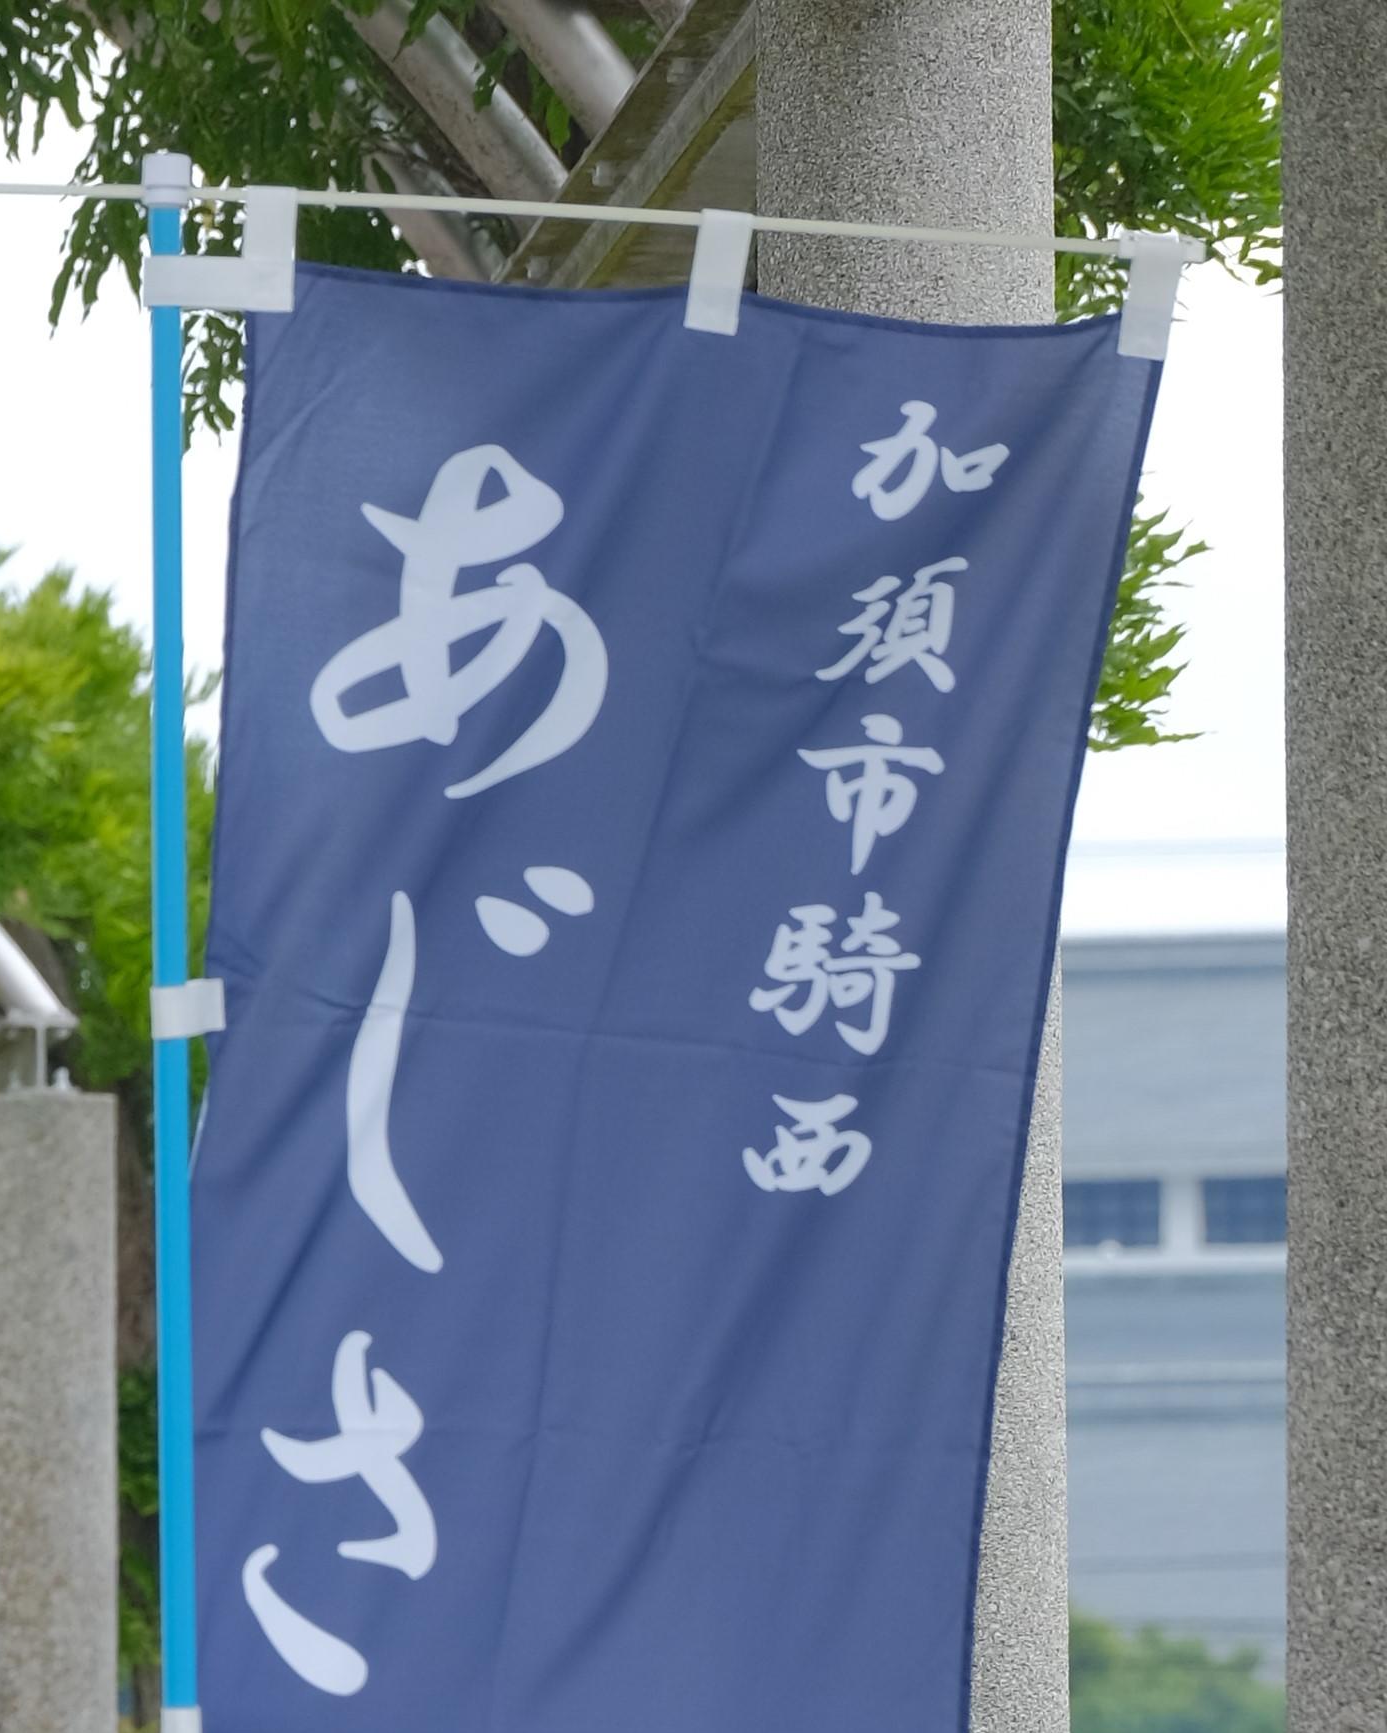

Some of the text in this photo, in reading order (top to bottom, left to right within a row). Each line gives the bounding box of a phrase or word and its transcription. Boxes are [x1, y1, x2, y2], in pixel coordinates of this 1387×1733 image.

[743, 398, 1011, 1198] 加須市騎西
